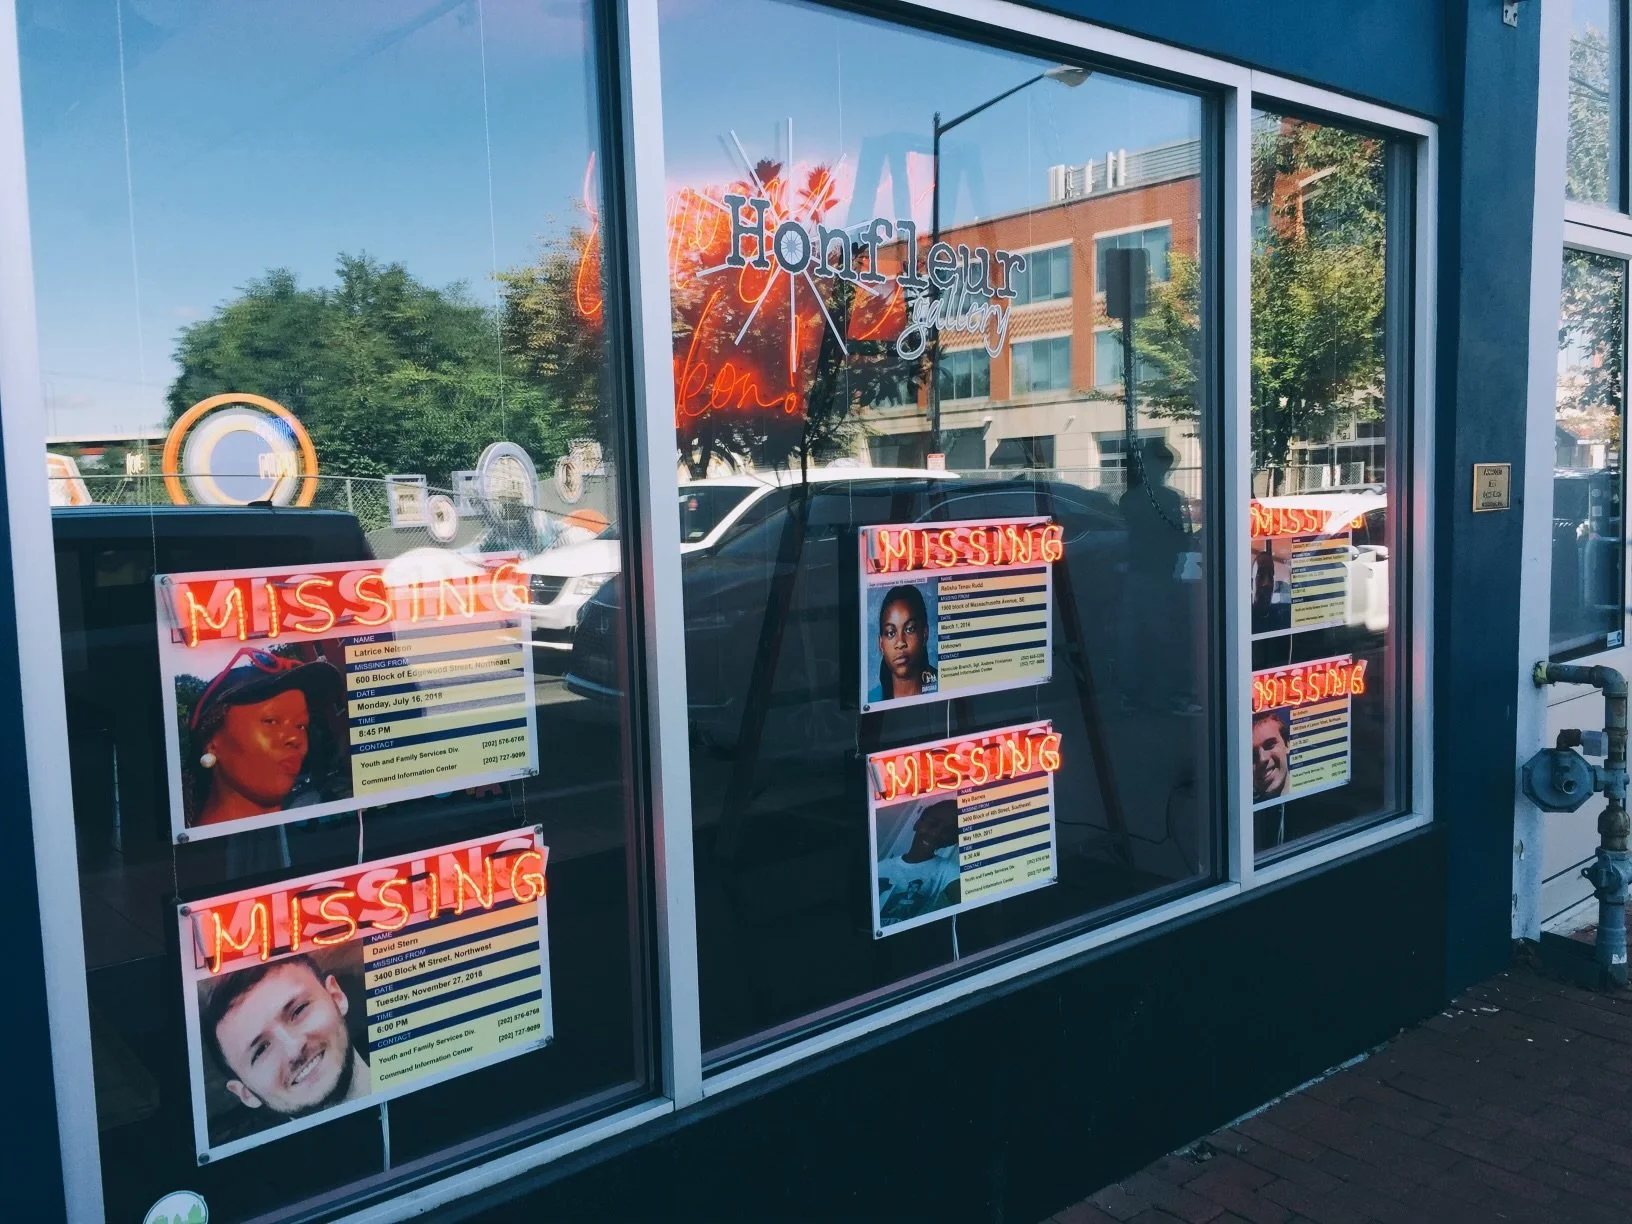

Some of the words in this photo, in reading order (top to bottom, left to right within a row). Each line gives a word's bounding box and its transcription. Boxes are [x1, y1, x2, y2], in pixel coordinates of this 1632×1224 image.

[724, 194, 1026, 298] Honfleur
[897, 269, 1010, 360] gallery
[879, 525, 1064, 573] MISSING
[185, 563, 529, 648] MISSING
[353, 636, 375, 644] NAME
[354, 647, 382, 657] Latrice
[384, 645, 411, 654] Nelson
[355, 661, 385, 671] MISSING
[387, 658, 408, 667] FROM
[356, 676, 370, 684] 600
[372, 672, 395, 682] Block
[475, 658, 510, 668] Northeast
[1254, 665, 1365, 712] MISSING
[358, 701, 391, 711] Monday,
[393, 697, 409, 707] July
[412, 695, 422, 704] 16,
[359, 728, 376, 737] 8:45
[359, 740, 394, 751] CONTACT
[361, 760, 380, 769] Youth
[396, 753, 418, 763] Family
[419, 749, 446, 759] Services
[885, 735, 1061, 800] MISSING
[362, 775, 396, 786] Command
[397, 768, 434, 779] Information
[436, 764, 457, 772] Center
[209, 851, 546, 973] MISSING
[372, 932, 392, 942] NAME
[372, 943, 395, 956] David
[397, 937, 418, 948] Stern
[373, 956, 404, 969] MISSING
[405, 949, 426, 960] FROM
[374, 971, 393, 982] 3400
[395, 965, 417, 976] Block
[427, 956, 452, 967] Street,
[454, 943, 492, 958] Northwest
[374, 984, 394, 995] DATE
[376, 994, 410, 1009] Tuesday,
[412, 980, 450, 997] November
[452, 976, 464, 986] 27,
[377, 1012, 393, 1020] TIME
[377, 1024, 394, 1034] 6:00
[395, 1019, 408, 1028] PM
[377, 1033, 411, 1048] CONTACT
[379, 1053, 398, 1064] Youth
[400, 1049, 412, 1058] and
[413, 1042, 434, 1054] Family
[436, 1034, 463, 1046] Services
[464, 1029, 476, 1039] Div.
[380, 1066, 414, 1081] Command
[415, 1053, 451, 1070] Information
[452, 1046, 473, 1057] Center
